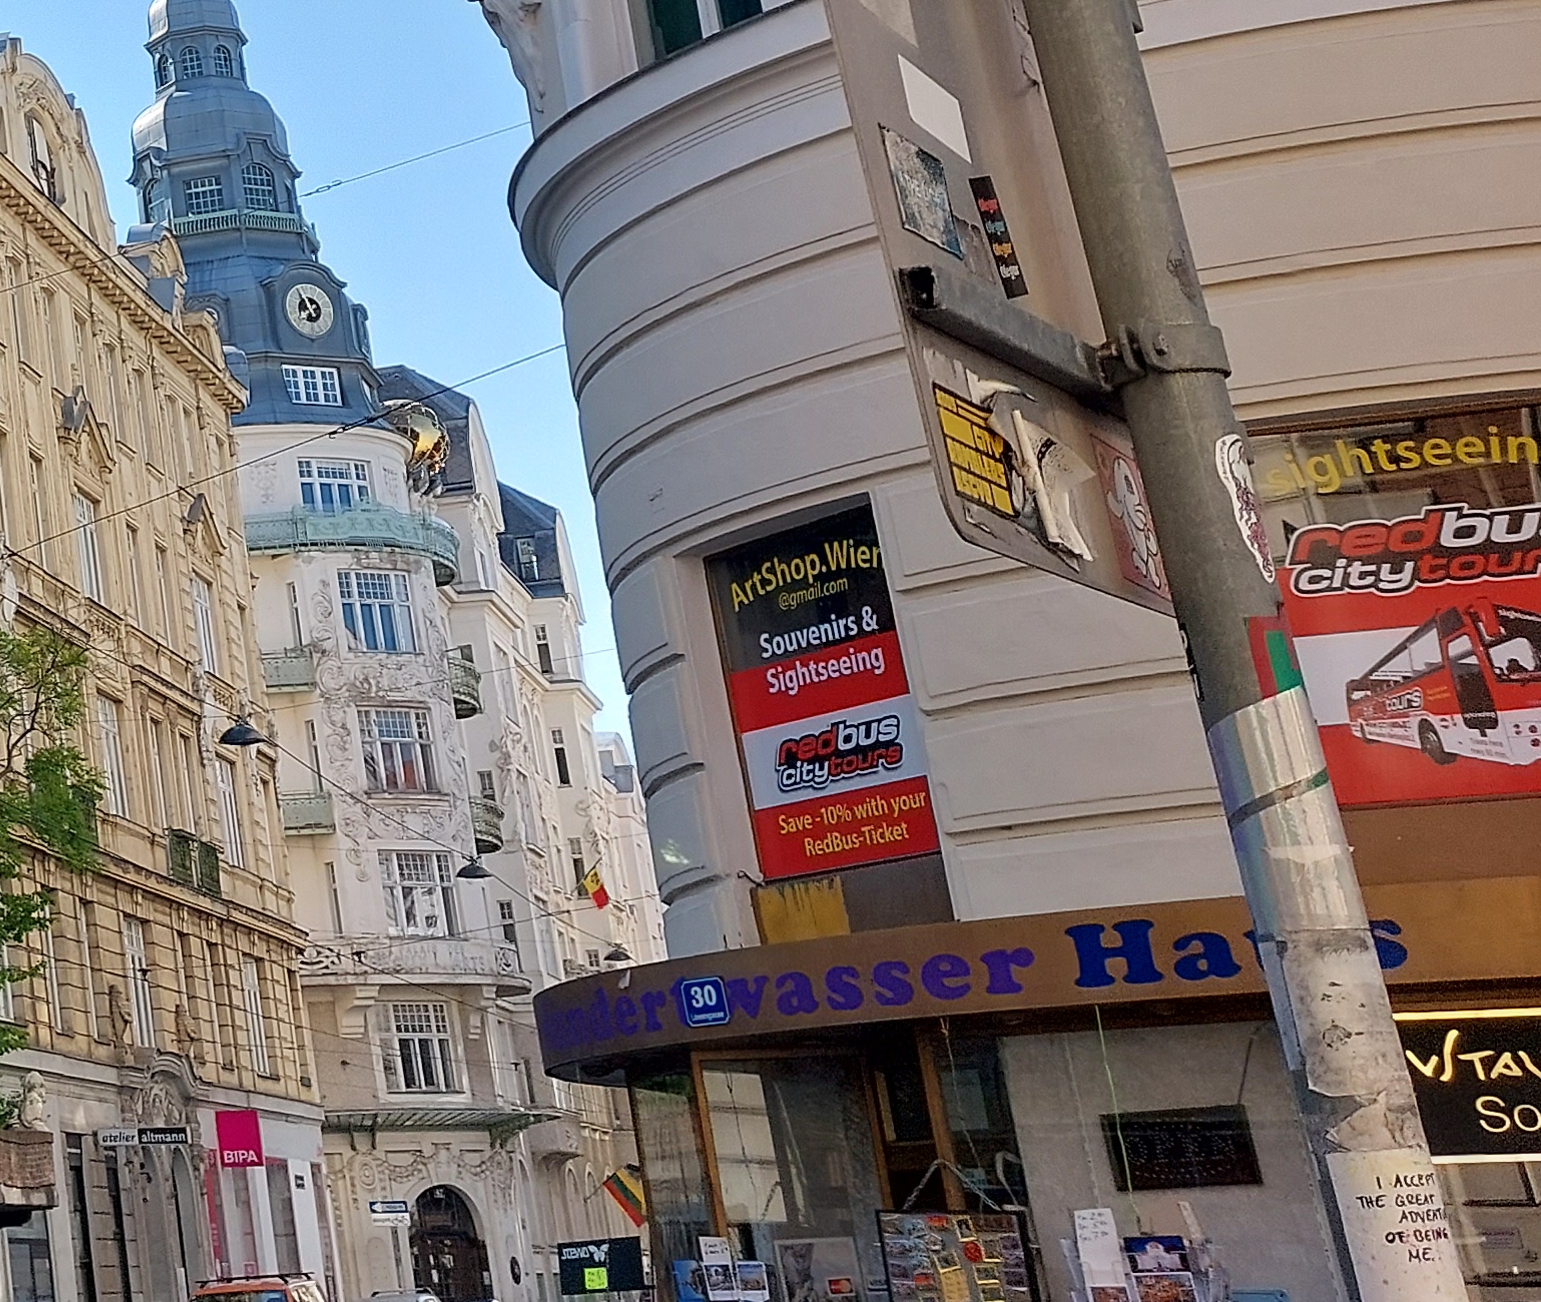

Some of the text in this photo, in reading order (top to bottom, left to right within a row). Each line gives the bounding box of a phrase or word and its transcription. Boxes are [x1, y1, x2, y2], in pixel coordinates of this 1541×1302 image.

[1293, 509, 1541, 562] redbu
[778, 576, 849, 611] @gmail.com
[759, 605, 880, 659] Souvenirs &
[766, 647, 885, 696] Sightseeing
[778, 716, 900, 764] redbus
[781, 745, 902, 786] citytours
[778, 790, 927, 835] Save -10% with your
[804, 820, 910, 857] RedBus-Ticket
[1064, 918, 1408, 988] Has
[690, 984, 717, 1008] 30
[101, 1129, 188, 1144] atelier altmann
[223, 1150, 258, 1164] BIPA
[1375, 1172, 1436, 1190] I ACCEPT
[1355, 1192, 1436, 1209] THE GREAT
[1385, 1226, 1450, 1244] OF BEING
